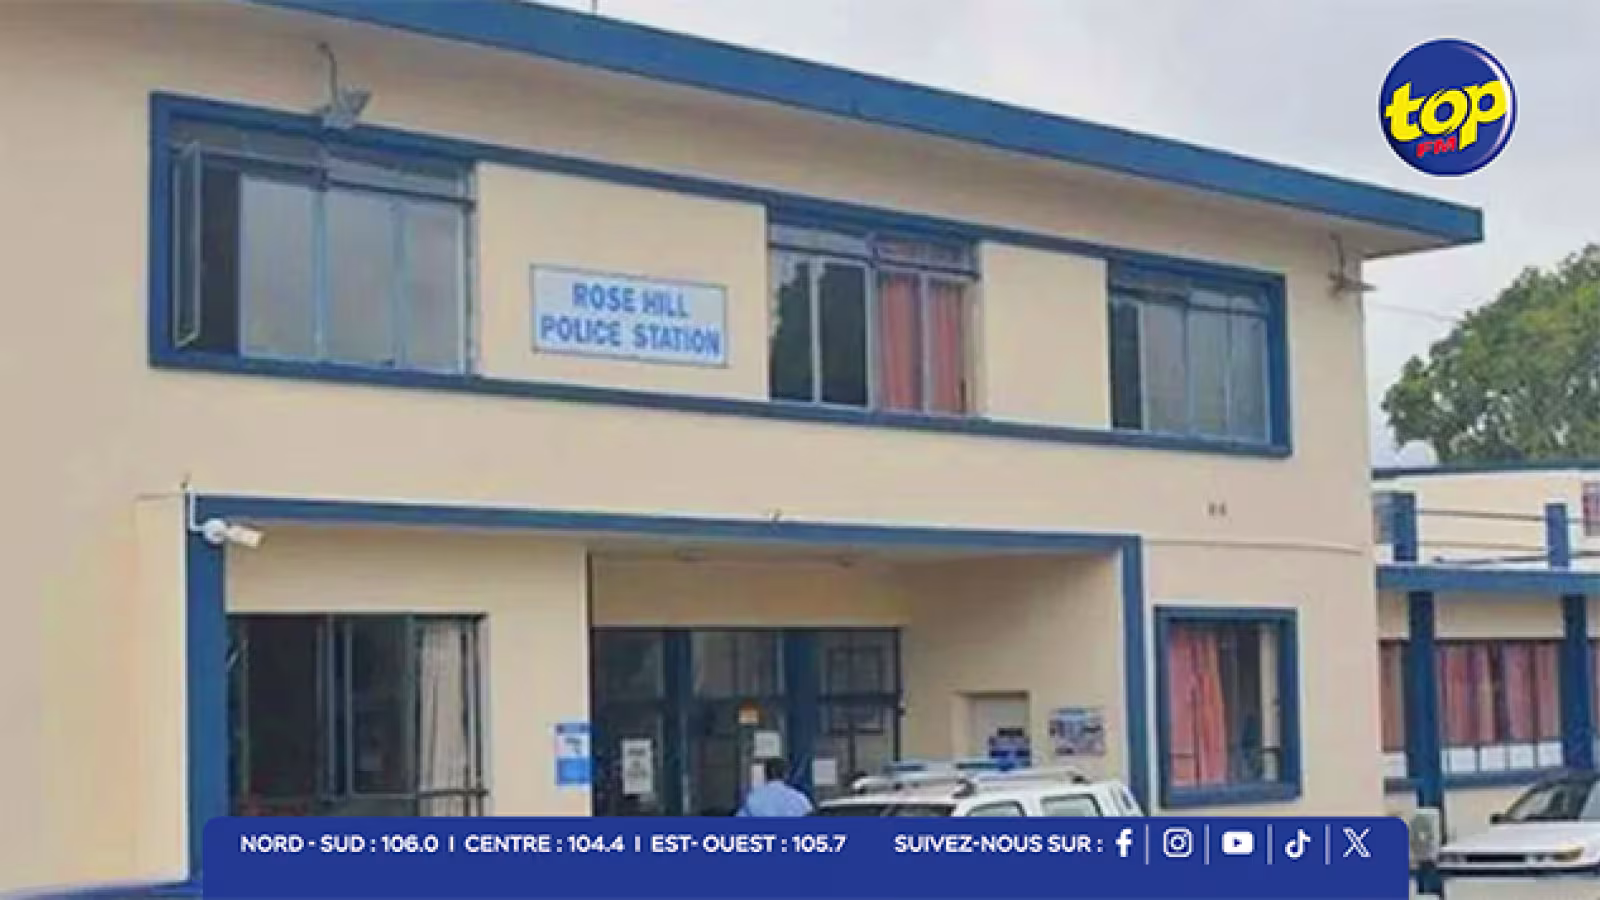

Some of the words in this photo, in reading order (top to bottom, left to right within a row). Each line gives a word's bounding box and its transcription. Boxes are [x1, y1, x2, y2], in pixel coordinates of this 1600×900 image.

[572, 282, 636, 313] ROSE
[641, 290, 689, 319] HILL
[540, 314, 622, 347] POLICE
[632, 321, 721, 356] STATION
